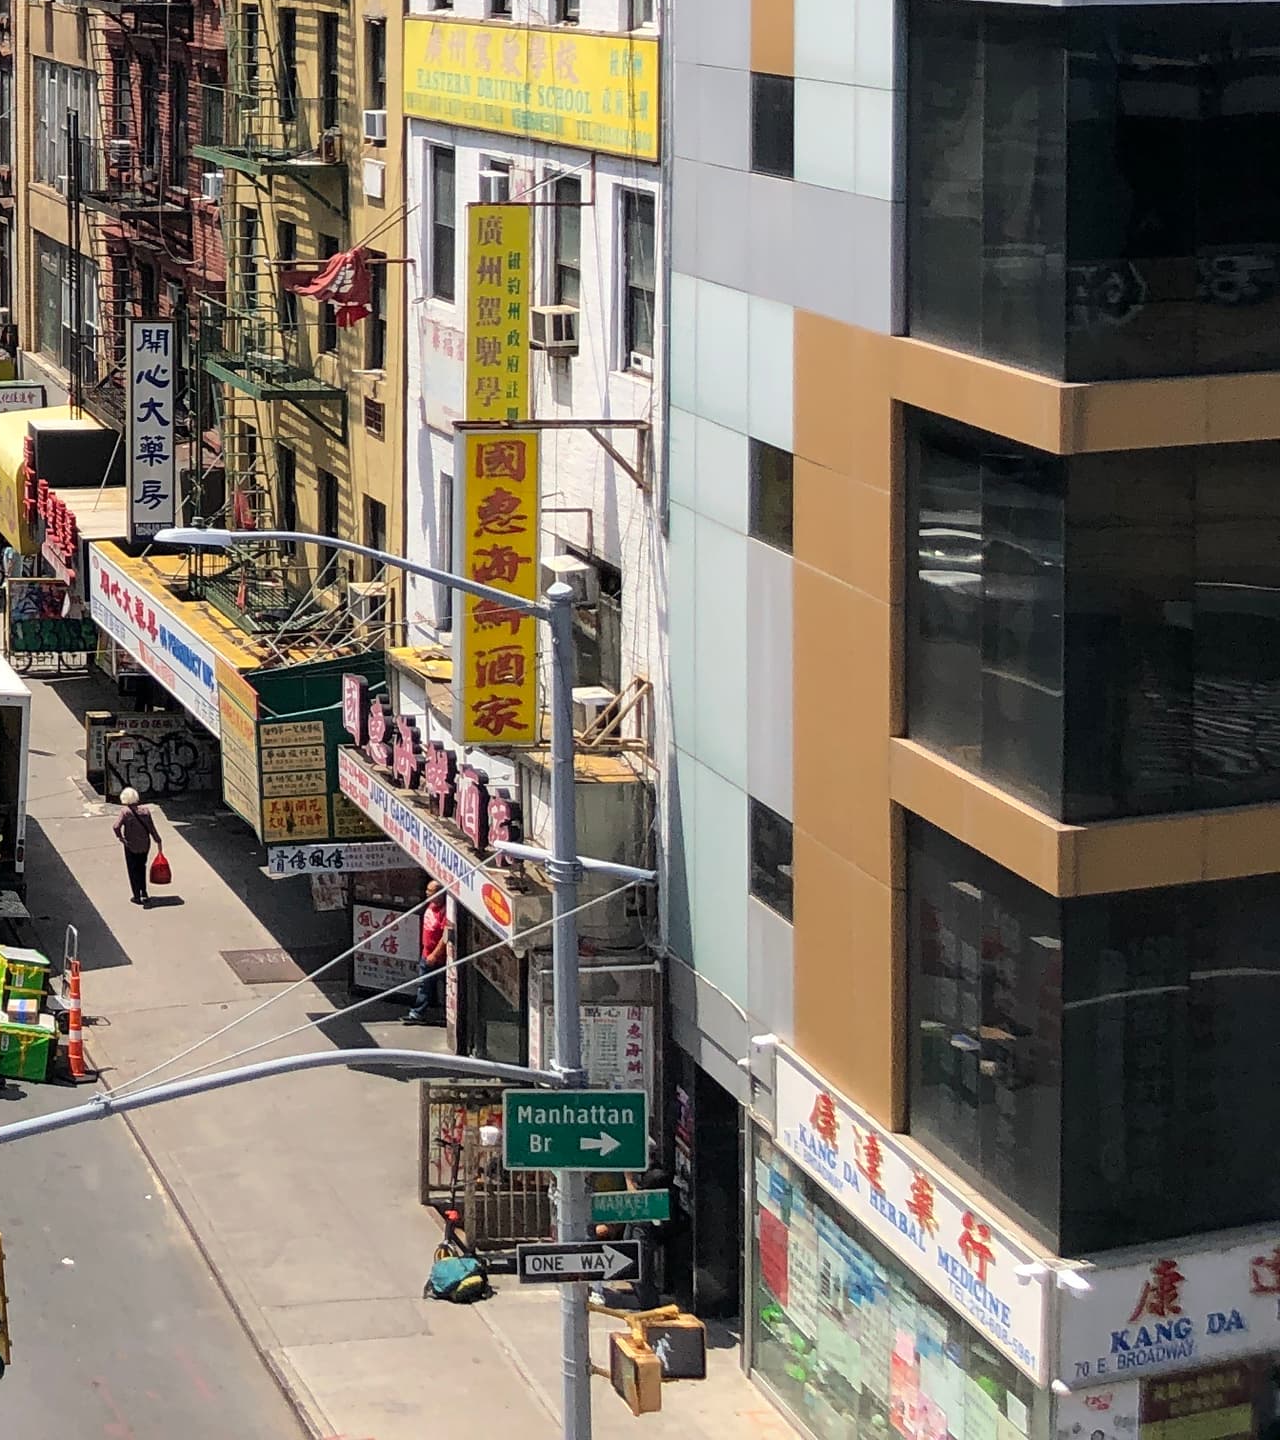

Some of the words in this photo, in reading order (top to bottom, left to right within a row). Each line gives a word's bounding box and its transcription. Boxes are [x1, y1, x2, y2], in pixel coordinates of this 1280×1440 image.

[416, 68, 471, 96] EASTERN
[477, 76, 531, 105] DRIVING
[538, 85, 592, 114] SCHOOL
[475, 216, 503, 420] 廣州駕駛學
[135, 328, 170, 510] 開心大藥房
[391, 798, 421, 841] GARDEN
[423, 823, 476, 891] RESTAURANT
[517, 1105, 635, 1125] Manhattan
[529, 1134, 553, 1153] Br
[593, 1194, 649, 1211] MARKET
[798, 1123, 839, 1170] KANG
[842, 1160, 860, 1193] DA
[869, 1184, 927, 1253] HERBAL
[937, 1245, 1011, 1329] MEDICINE
[531, 1257, 565, 1272] ONE
[580, 1254, 614, 1271] WAY
[1111, 1317, 1193, 1354] KANG
[1207, 1309, 1244, 1336] DA
[1117, 1339, 1195, 1371] BROADWAY
